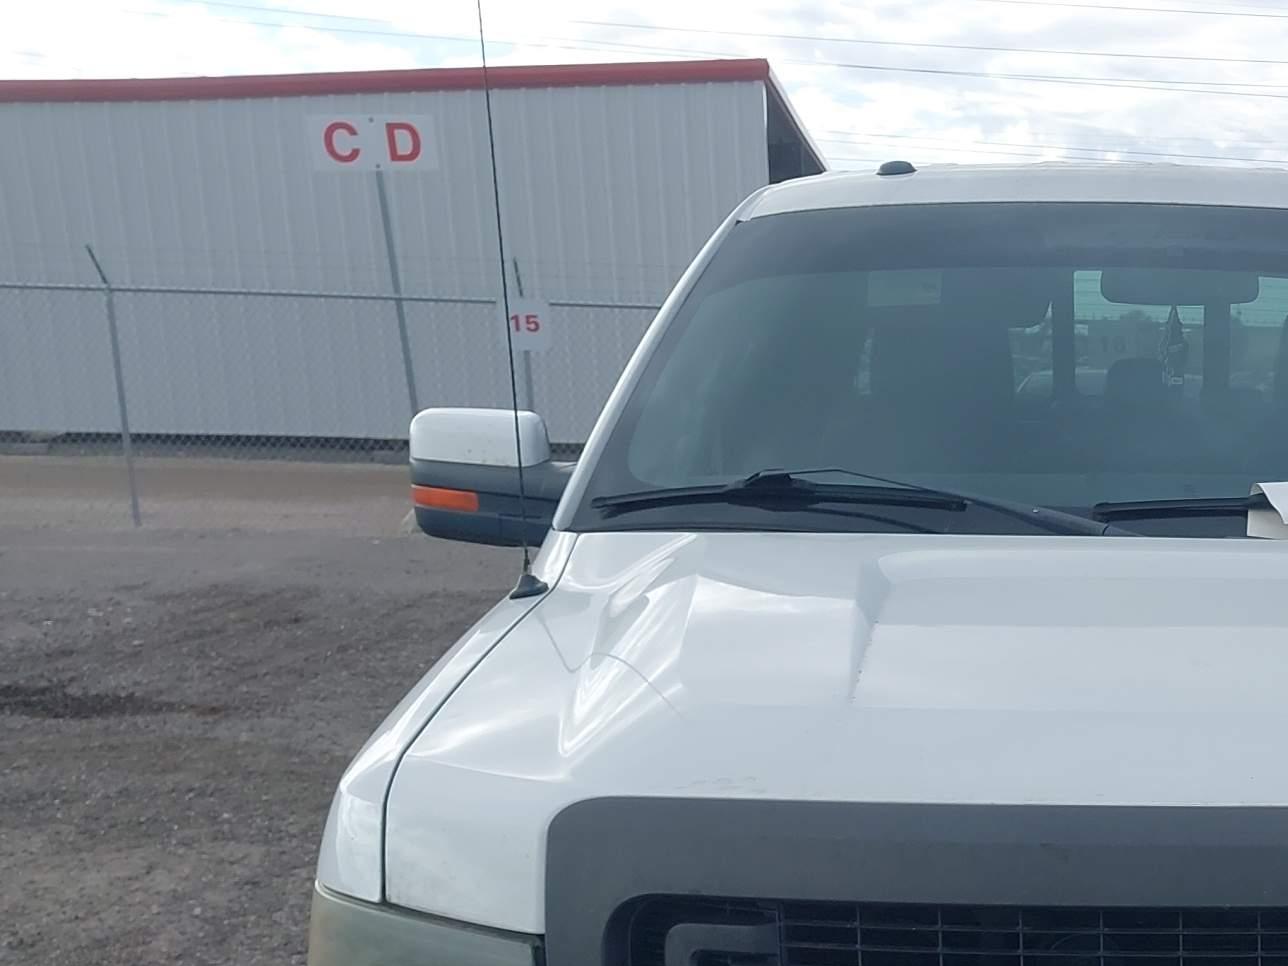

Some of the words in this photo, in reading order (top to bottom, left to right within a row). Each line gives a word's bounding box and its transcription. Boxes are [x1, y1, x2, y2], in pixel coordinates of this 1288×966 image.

[323, 121, 361, 163] C
[385, 122, 422, 162] D
[511, 314, 540, 332] 15
